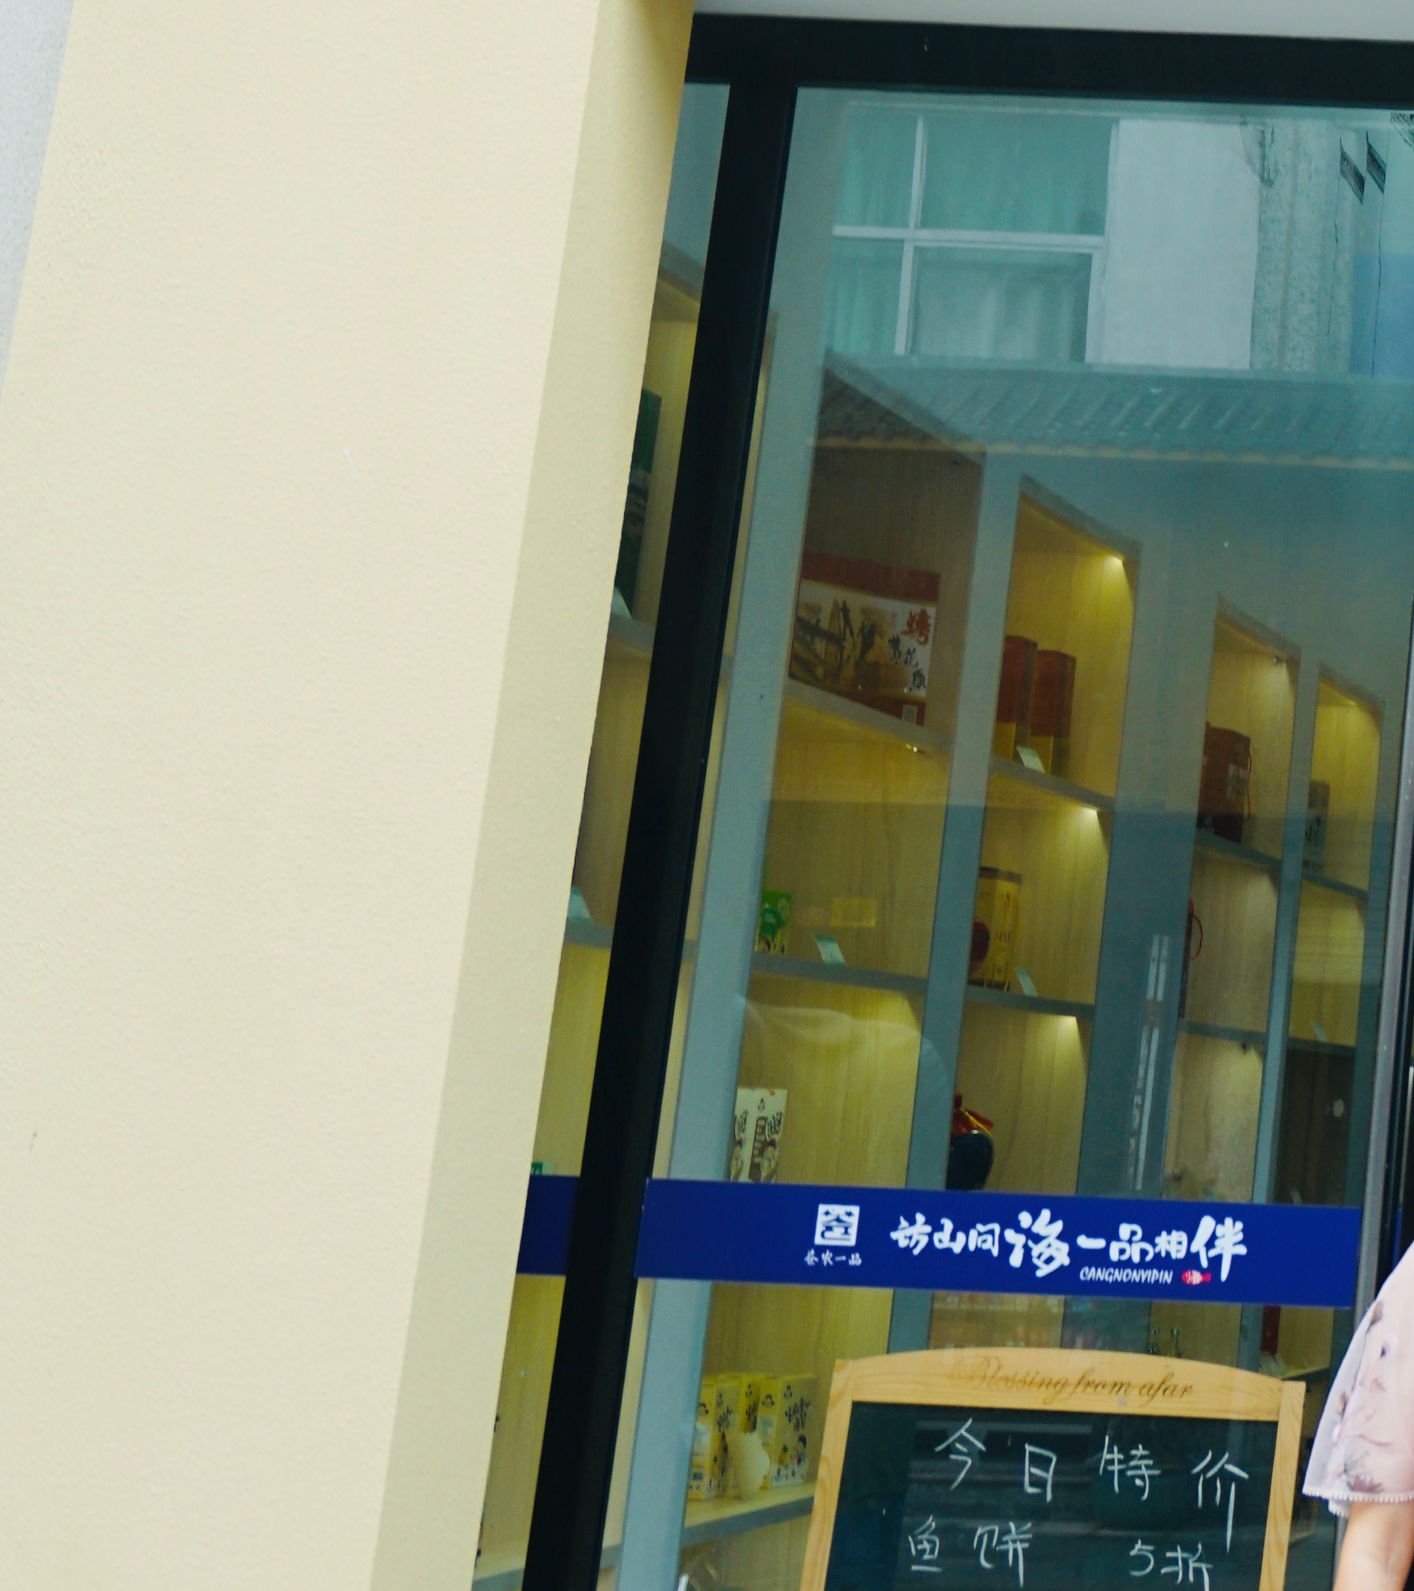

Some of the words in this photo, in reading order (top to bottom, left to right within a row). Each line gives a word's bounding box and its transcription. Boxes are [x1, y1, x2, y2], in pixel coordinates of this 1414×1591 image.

[1079, 1265, 1174, 1285] CANGNONYIPIN
[947, 1356, 1068, 1405] Blessing
[1066, 1367, 1132, 1401] from
[1137, 1371, 1195, 1406] afar
[934, 1417, 1250, 1554] 今日特价
[908, 1514, 1032, 1588] 鱼饼
